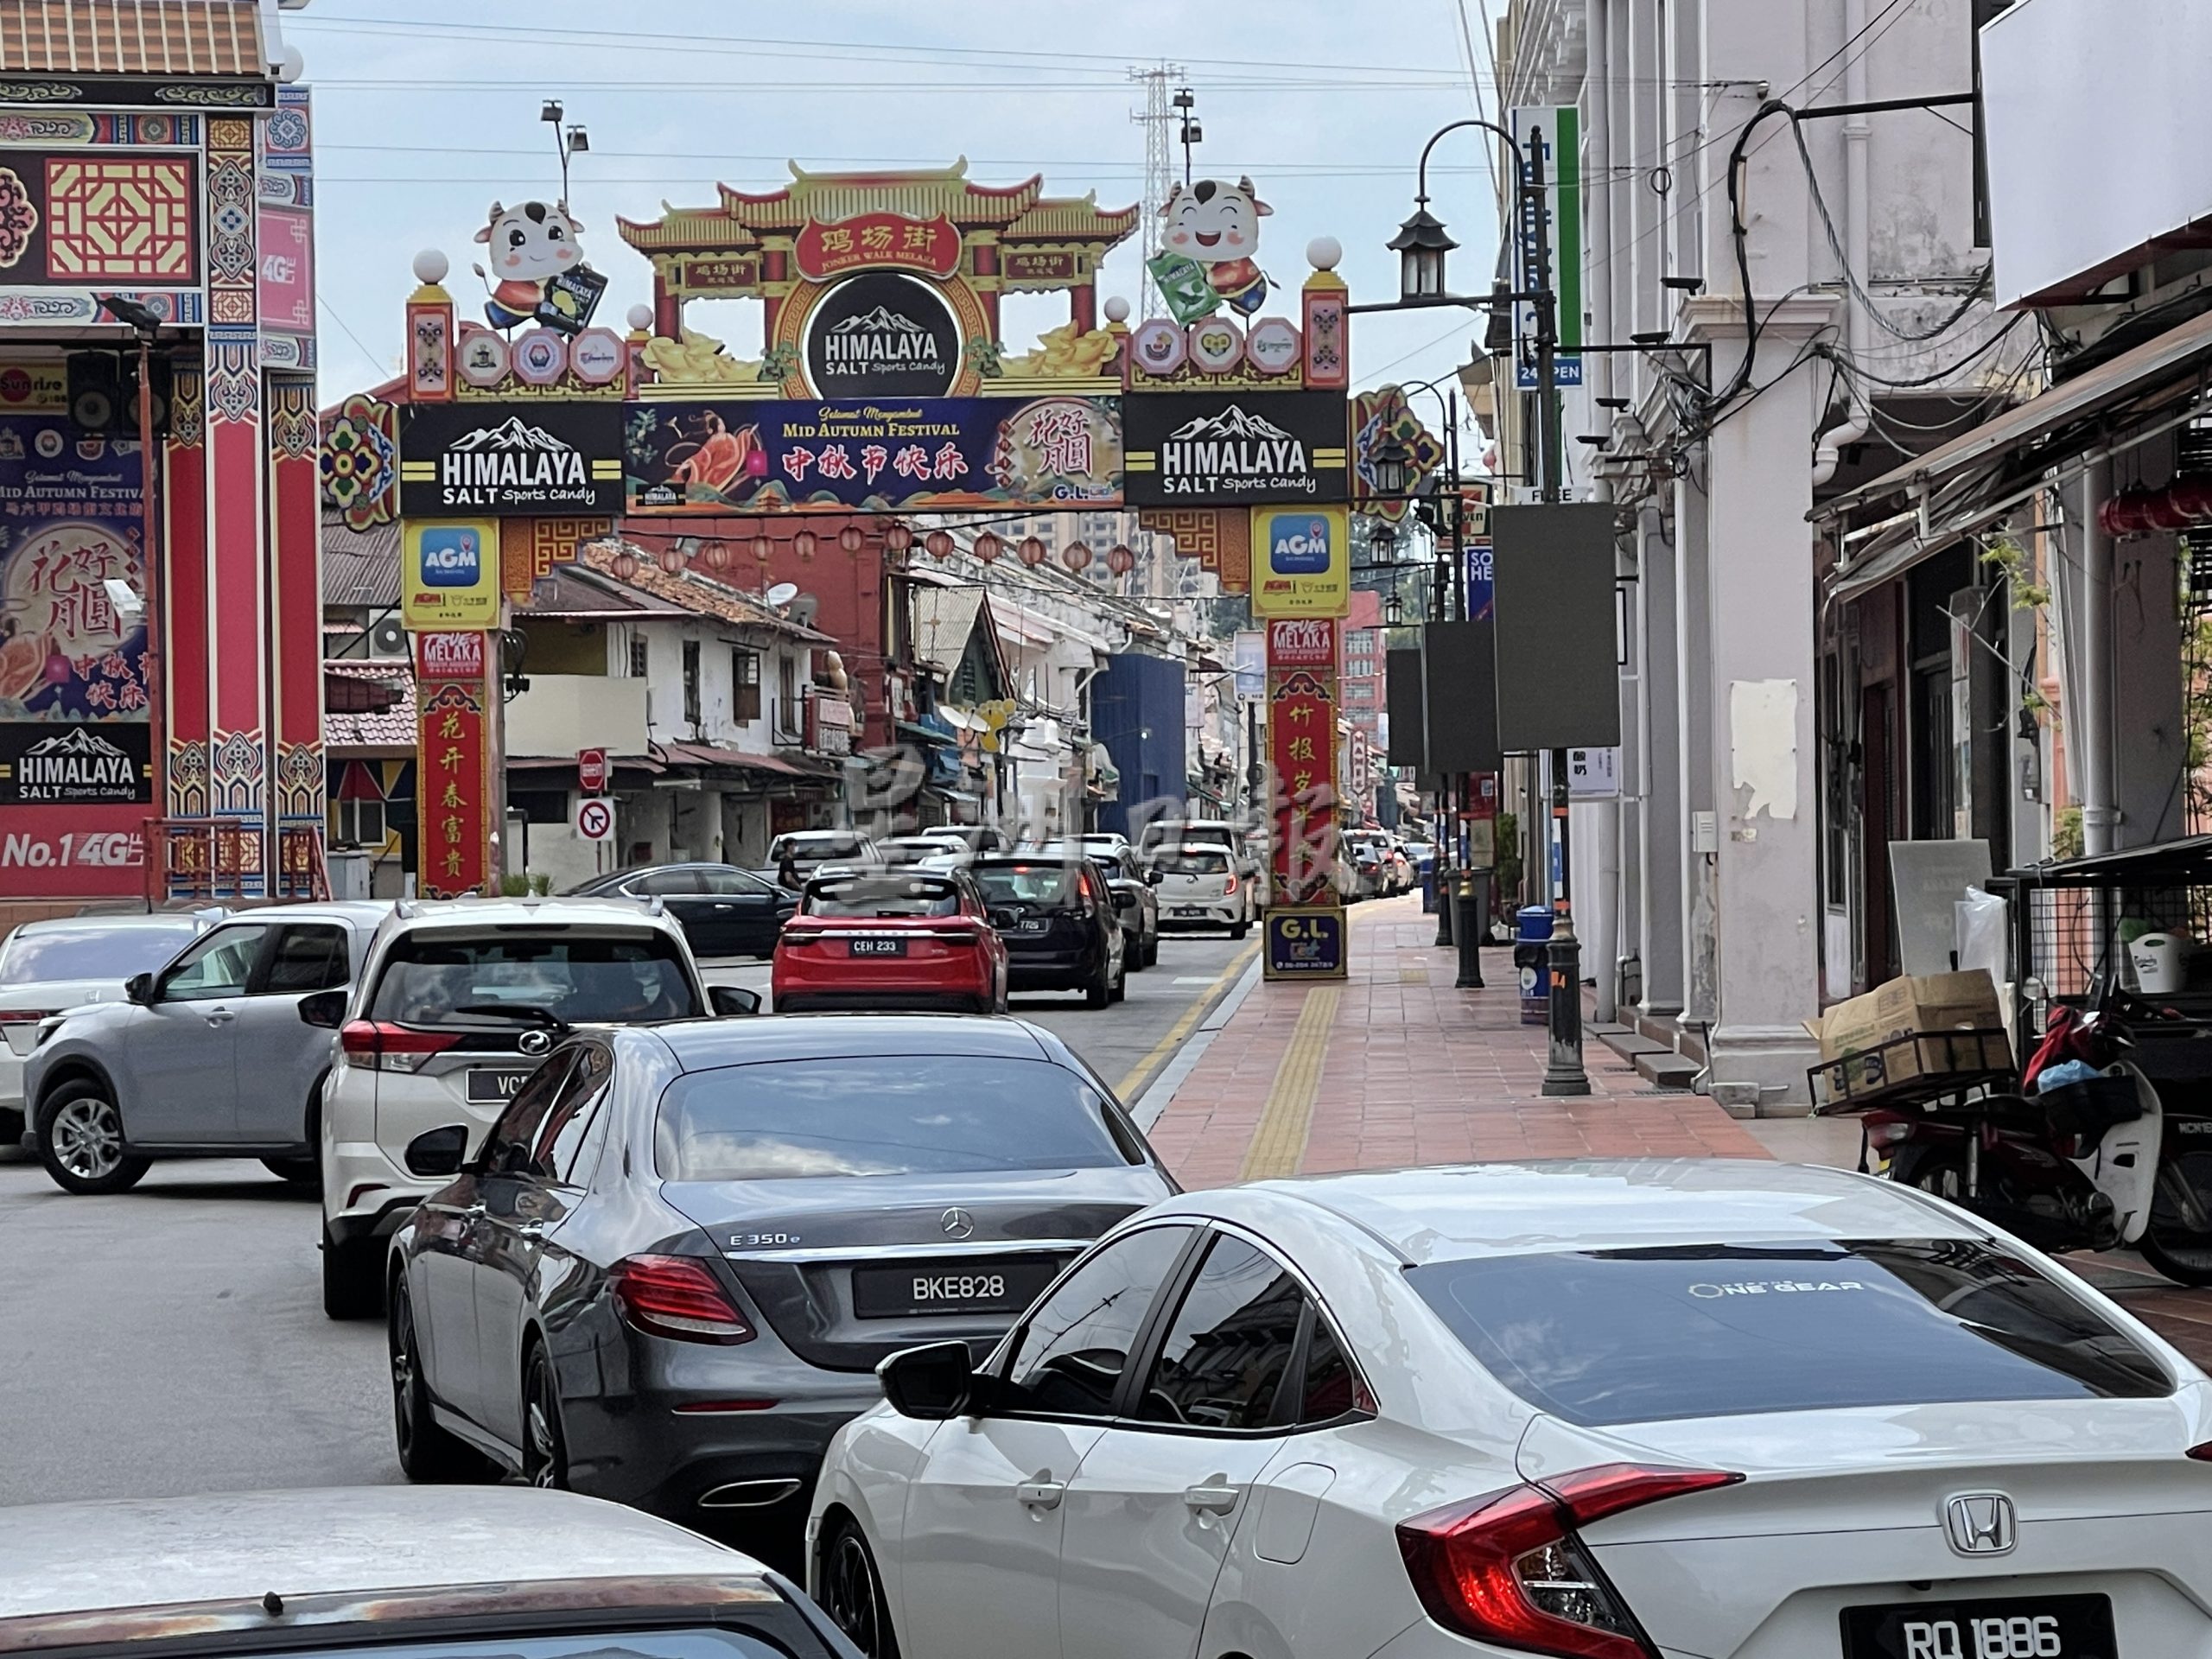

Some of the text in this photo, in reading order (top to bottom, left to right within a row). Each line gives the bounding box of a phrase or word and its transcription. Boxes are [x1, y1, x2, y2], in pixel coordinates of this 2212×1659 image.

[261, 255, 286, 283] 4G
[821, 251, 937, 272] JONKER WALK MELAKA
[825, 333, 938, 360] HIMALAYA
[826, 362, 868, 374] SALT
[872, 362, 906, 374] Sports
[818, 406, 861, 421] Selamat
[783, 423, 960, 437] MID AUTUMN FESTIVAL
[782, 442, 969, 486] 中秋节快乐
[1162, 441, 1306, 474] HIMALAYA
[442, 452, 587, 486] HIMALAYA
[24, 486, 86, 499] AUTUMN
[1163, 477, 1218, 493] SALT
[1223, 477, 1266, 493] Sports
[442, 488, 498, 504] SALT
[502, 488, 546, 505] Sports
[1532, 489, 1572, 502] FE
[1274, 535, 1326, 555] AGM
[425, 548, 476, 568] AGM
[1273, 632, 1330, 649] MELAKA
[424, 645, 481, 662] MELAKA
[19, 757, 135, 784] HIMALAYA
[19, 786, 61, 798] SALT
[63, 787, 98, 799] Sports
[438, 711, 468, 877] 花开春富贵
[2, 833, 73, 867] No.1
[78, 833, 129, 867] 4G
[1281, 918, 1329, 938] G.L.
[876, 941, 896, 951] 233
[498, 1076, 528, 1095] VC
[912, 1275, 1005, 1300] BKE828
[1774, 1281, 1865, 1293] GEAR
[1970, 1616, 2062, 1659] 1886
